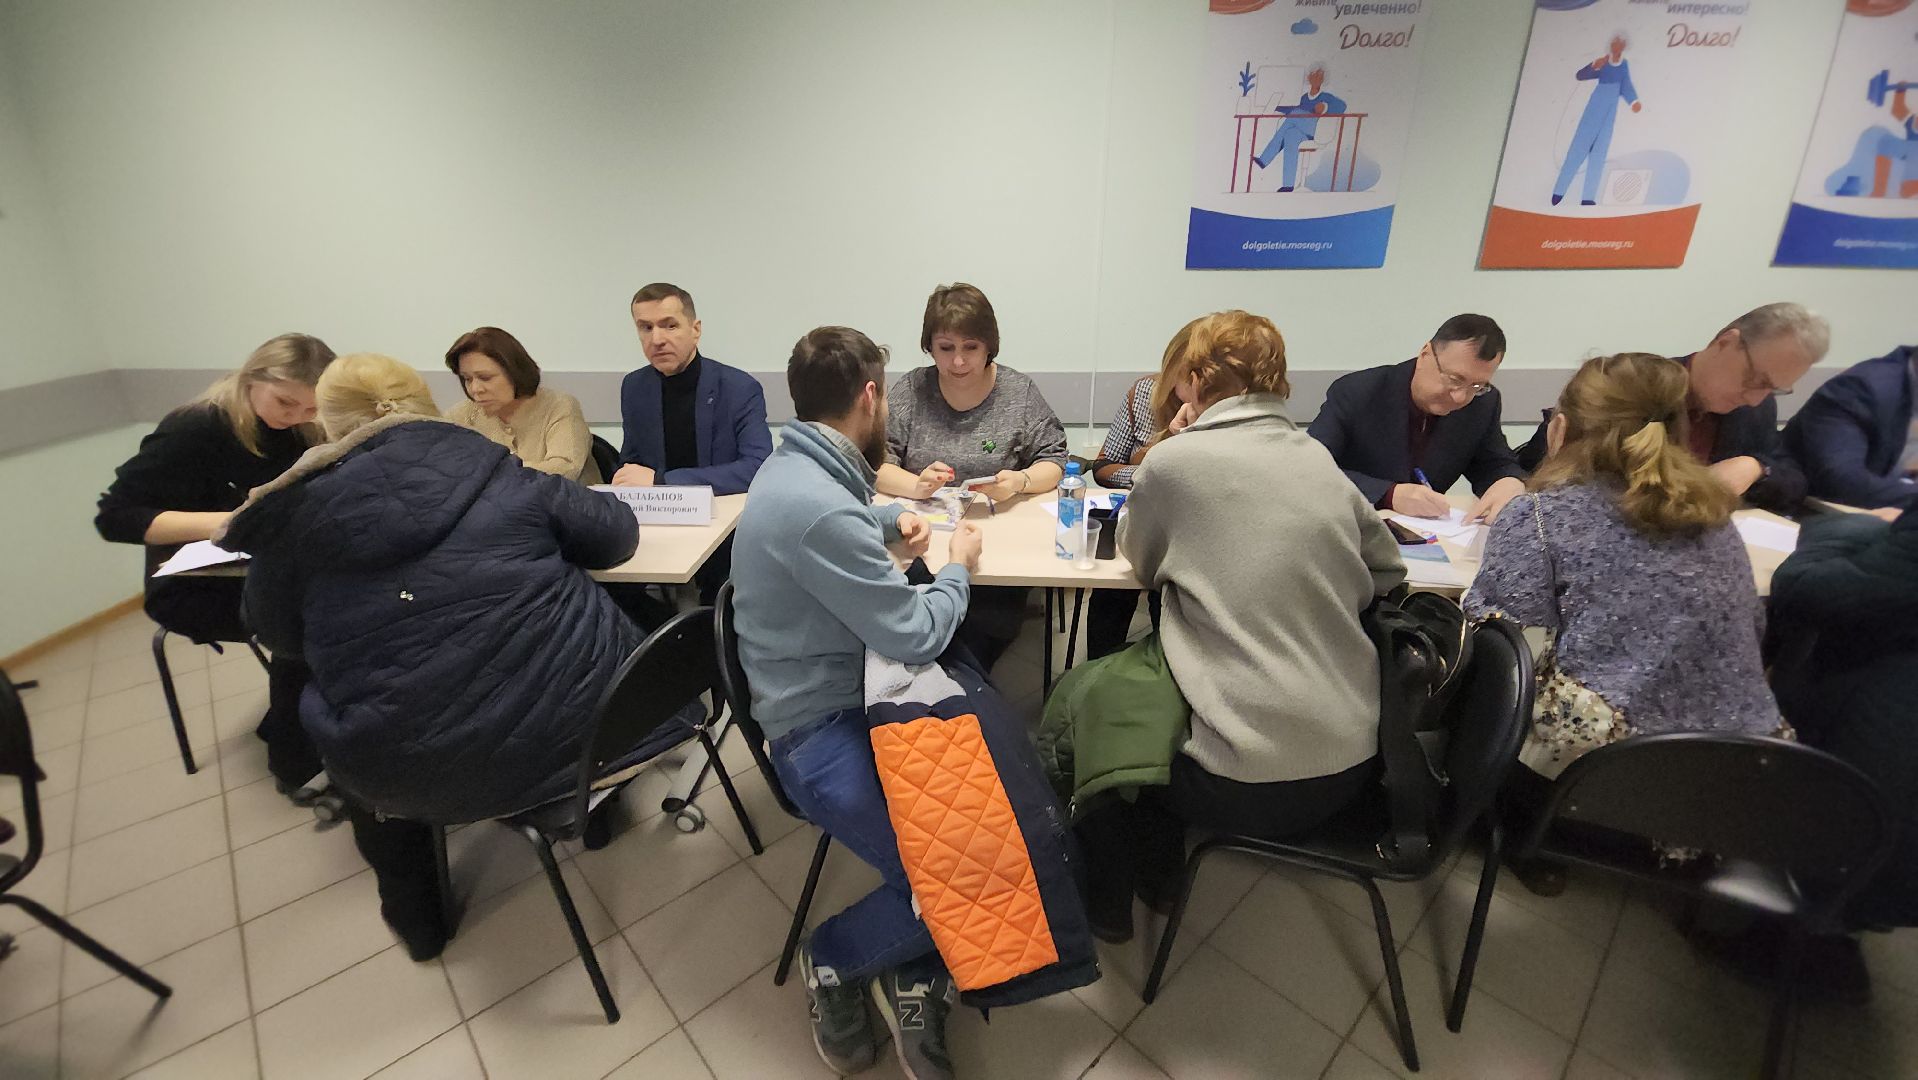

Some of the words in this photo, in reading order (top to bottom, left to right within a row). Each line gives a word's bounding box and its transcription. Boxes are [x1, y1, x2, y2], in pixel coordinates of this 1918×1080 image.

[1334, 2, 1421, 20] увлеченно!
[1667, 2, 1750, 18] интересно!
[1340, 24, 1415, 49] Долго!
[1667, 23, 1742, 47] Долго!
[1242, 240, 1333, 252] dolgoletie.mosreg.ru
[620, 492, 683, 501] БАЛАБАНОВ
[646, 504, 698, 514] Викторович
[898, 1000, 925, 1030] N
